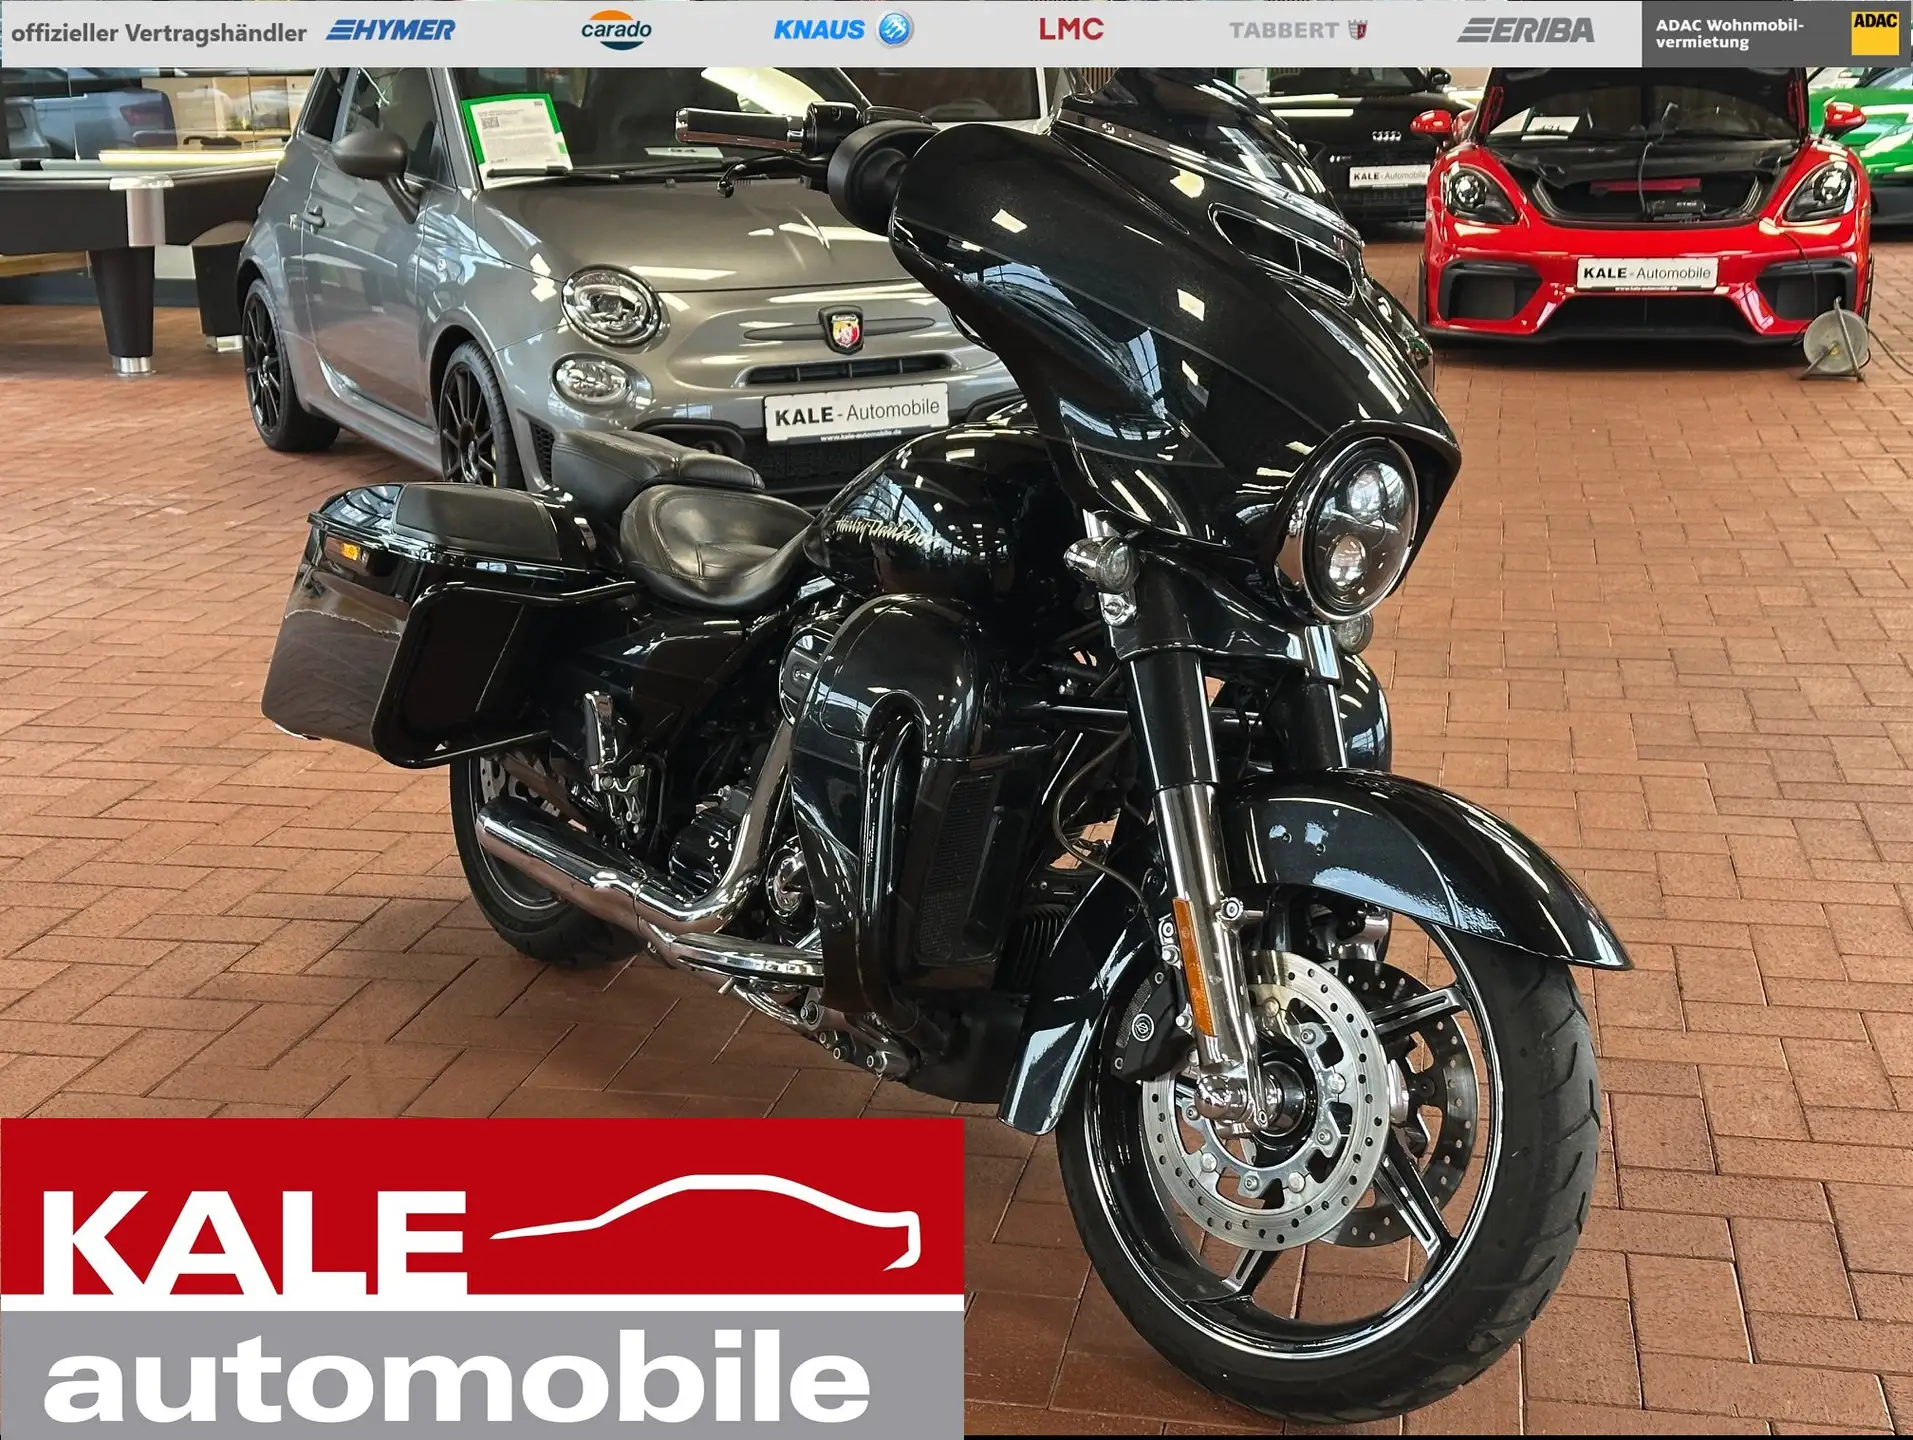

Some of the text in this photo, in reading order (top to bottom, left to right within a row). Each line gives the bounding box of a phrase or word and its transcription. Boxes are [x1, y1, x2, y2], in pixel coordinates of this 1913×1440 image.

[1354, 172, 1379, 180] KALE
[1584, 267, 1628, 279] KALE
[1636, 266, 1711, 279] Automobile
[775, 406, 834, 427] KALE
[846, 399, 940, 421] Automobile
